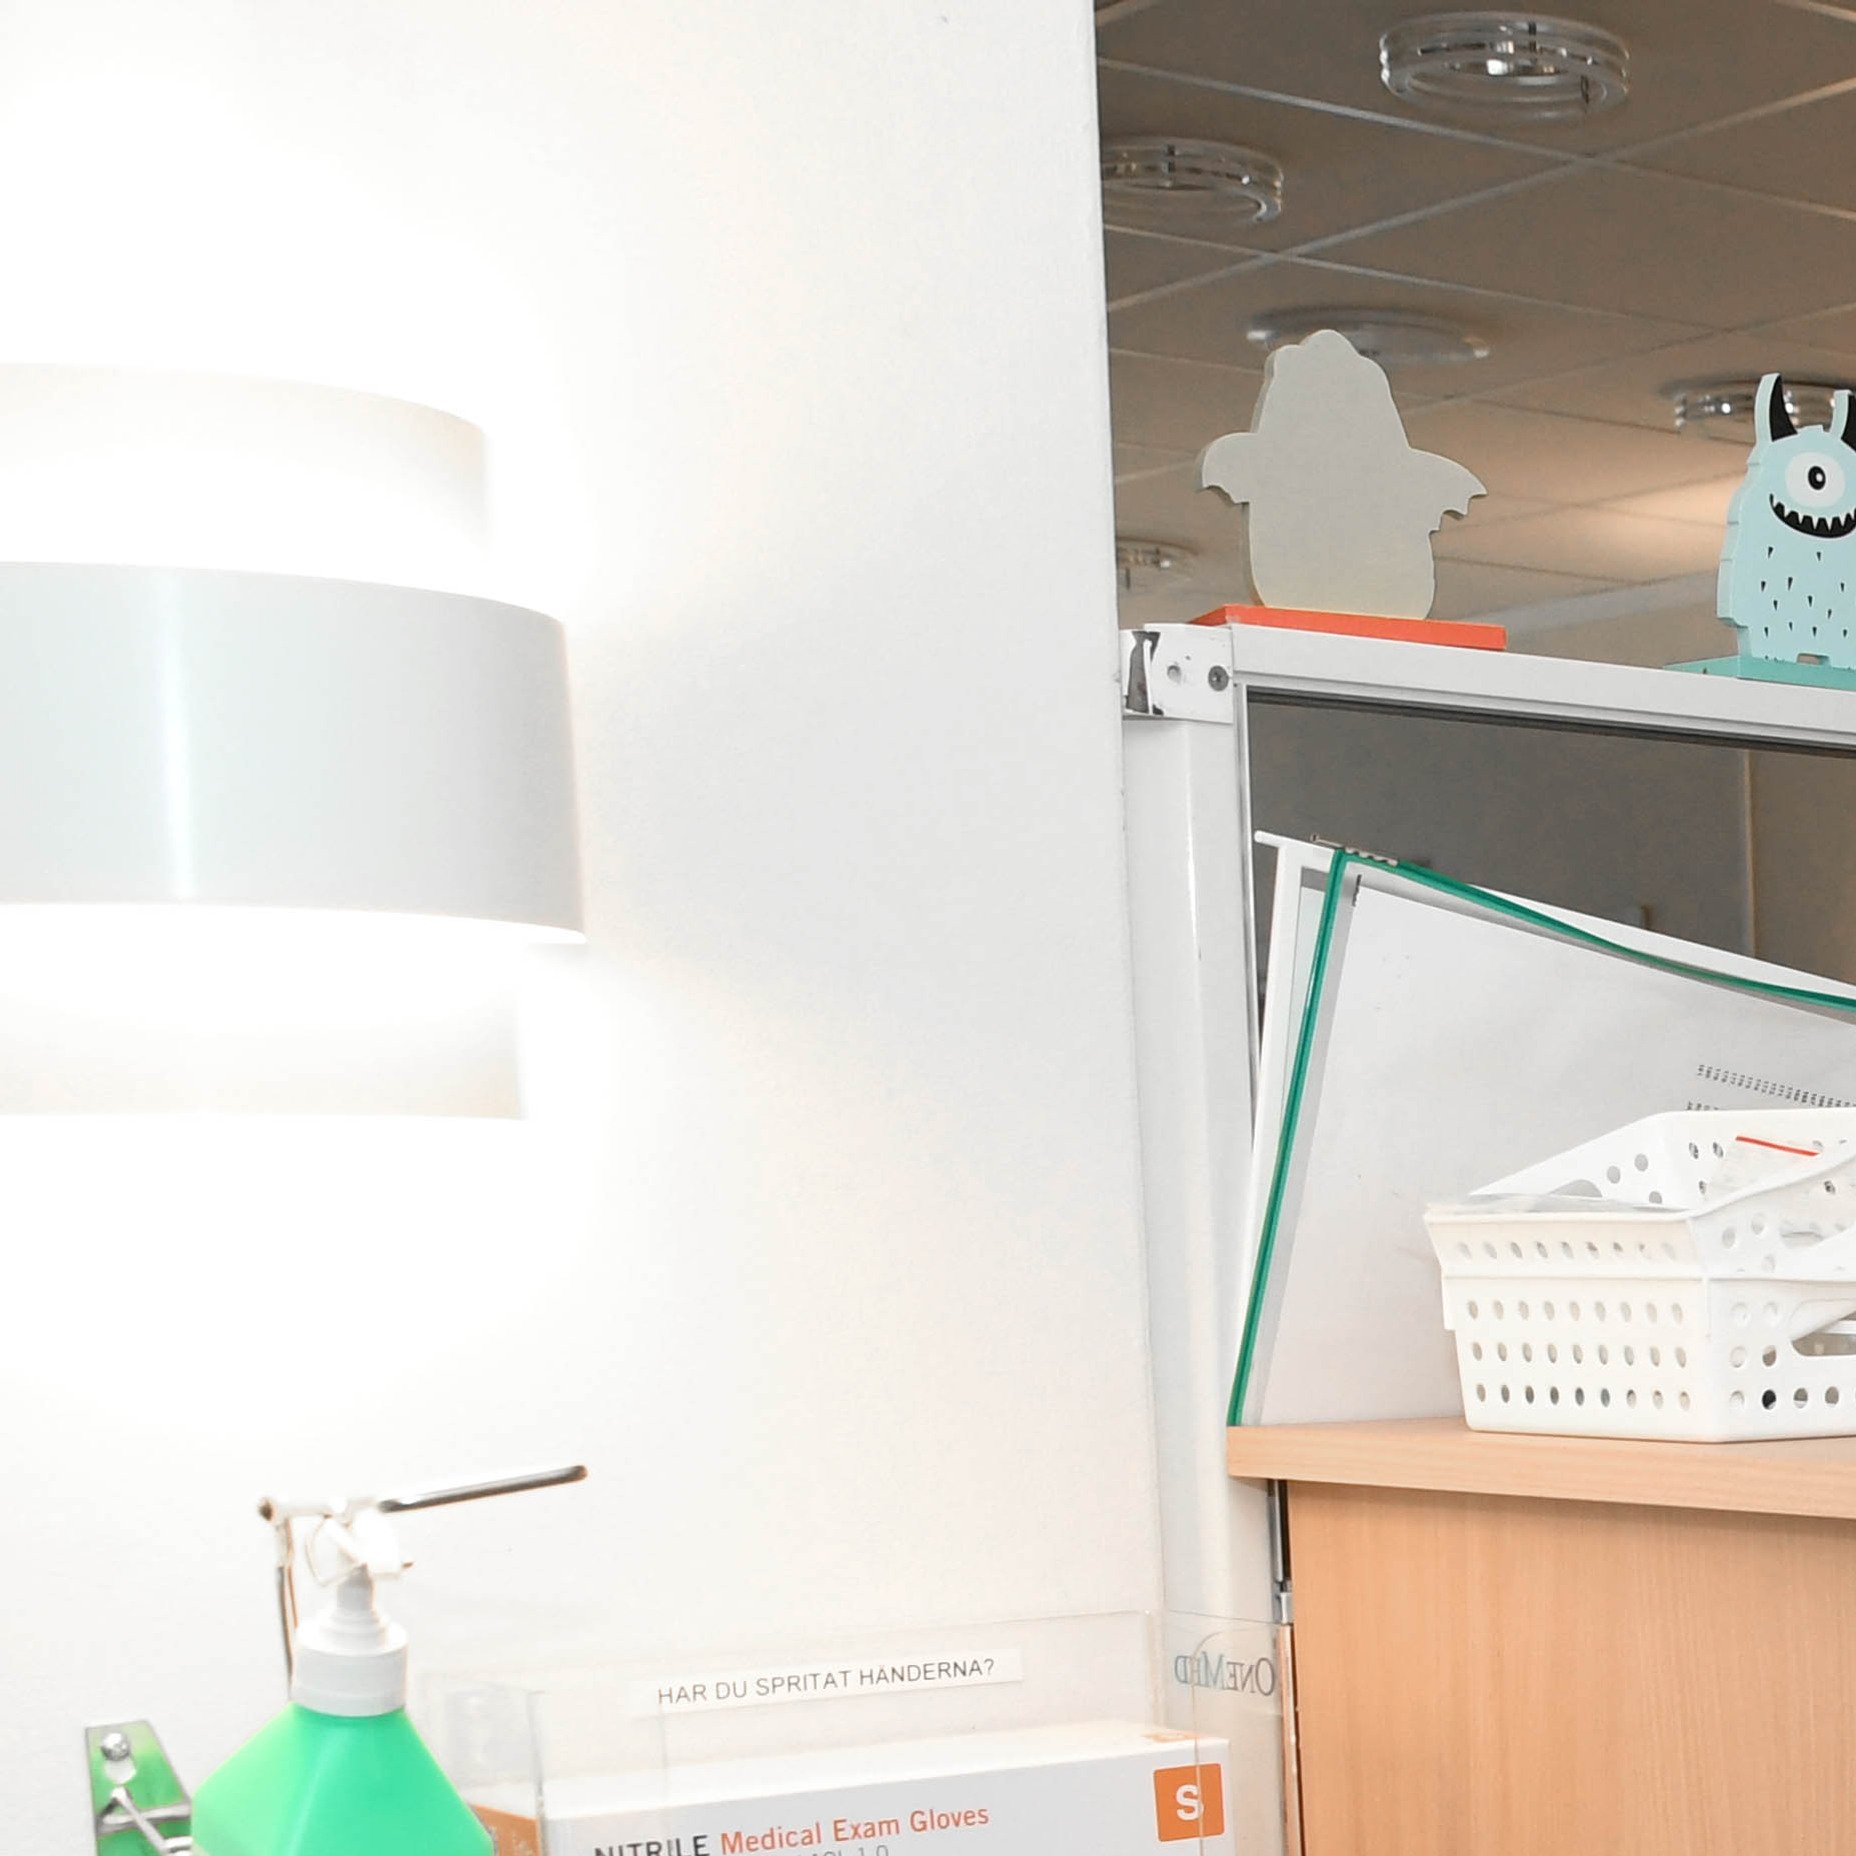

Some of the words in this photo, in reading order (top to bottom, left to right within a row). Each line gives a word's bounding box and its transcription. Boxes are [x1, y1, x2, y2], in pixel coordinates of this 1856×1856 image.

[657, 1683, 707, 1705] HAR
[715, 1680, 748, 1700] DU
[756, 1669, 852, 1697] SPRITAT
[859, 1657, 995, 1687] HÄNDERNA?
[1175, 1783, 1204, 1821] S
[720, 1821, 823, 1856] Medical
[833, 1816, 900, 1842] Exam
[909, 1806, 990, 1833] Gloves
